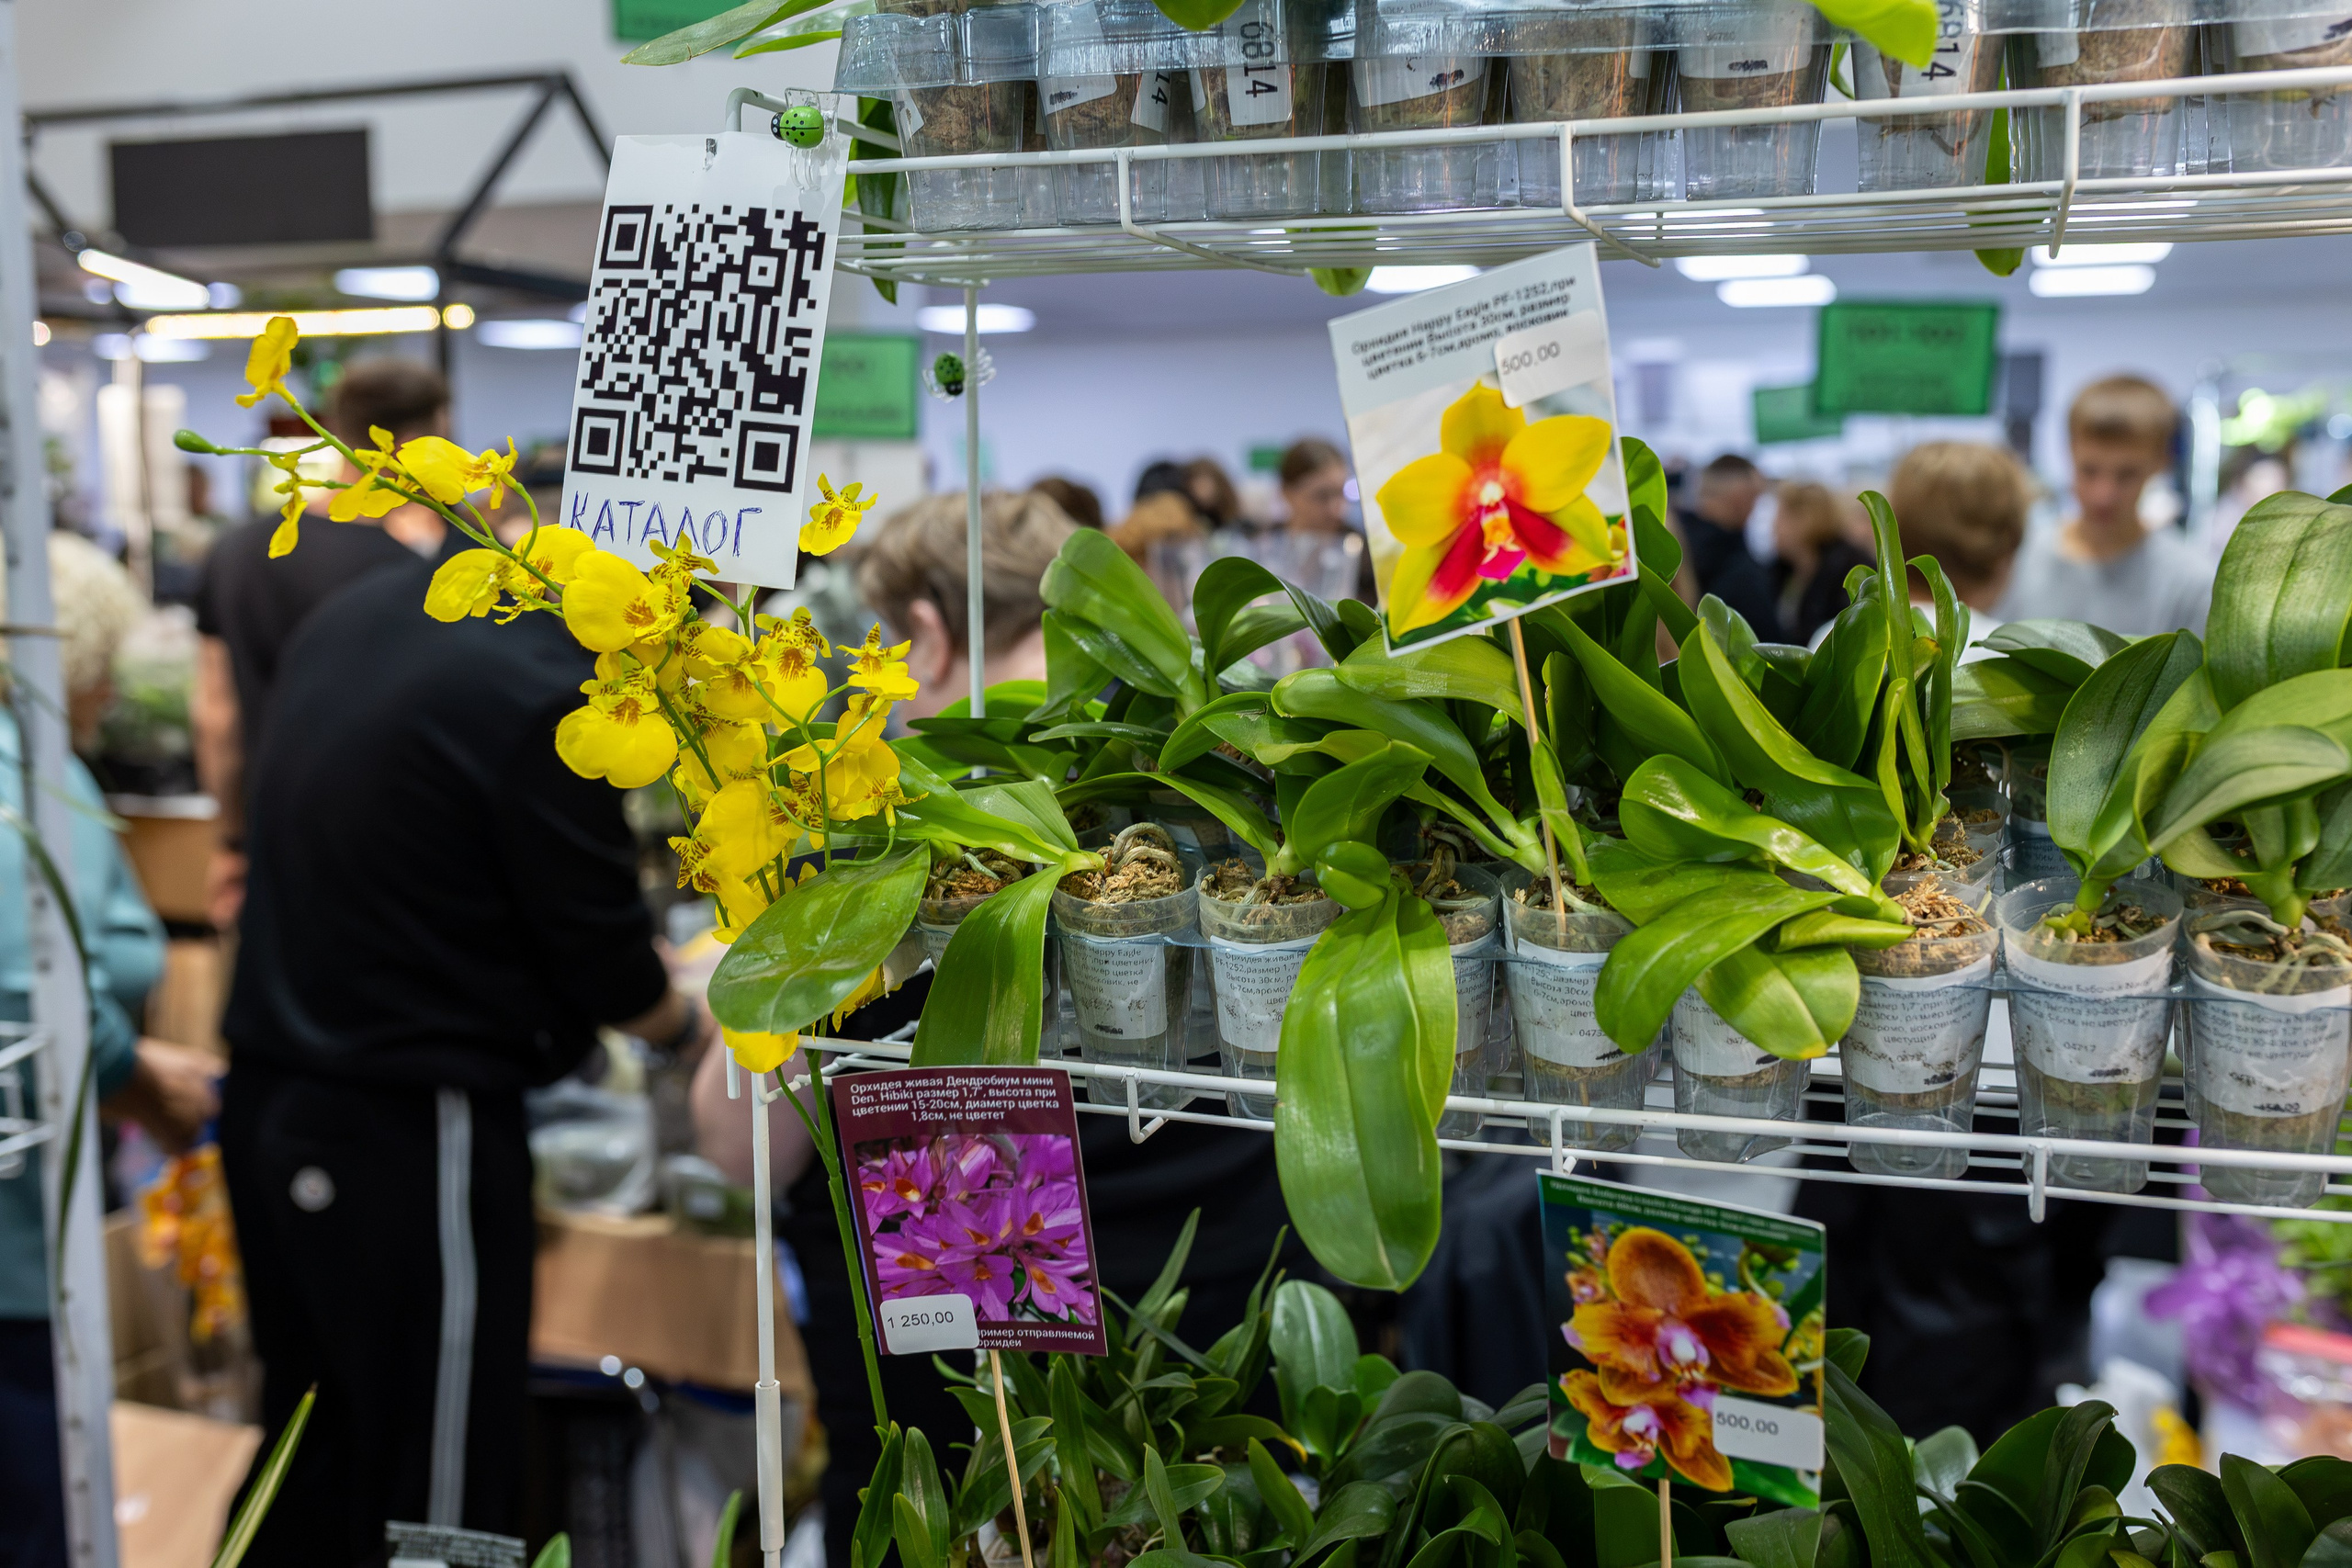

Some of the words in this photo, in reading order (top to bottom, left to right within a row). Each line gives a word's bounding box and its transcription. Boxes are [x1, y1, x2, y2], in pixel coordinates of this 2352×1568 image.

[1240, 21, 1278, 98] 6814
[1455, 299, 1490, 321] Eagle
[571, 491, 763, 558] КАТАЛОГ
[1225, 952, 1262, 964] Орхидея
[1265, 954, 1295, 964] живая
[1283, 961, 1300, 972] 1,7"
[1883, 1032, 1937, 1045] цветущий
[851, 1079, 902, 1094] Орхидея
[905, 1077, 944, 1089] живая
[946, 1075, 1020, 1089] Дендробиум
[1023, 1077, 1054, 1086] мини
[851, 1094, 877, 1105] Den.
[880, 1089, 914, 1101] Hibiki
[916, 1089, 959, 1101] размер
[989, 1088, 1032, 1098] высота
[1035, 1088, 1057, 1099] при
[852, 1103, 910, 1117] цветении
[910, 1100, 963, 1111] 15-20см,
[966, 1100, 1015, 1111] диаметр
[1017, 1100, 1060, 1110] цветка
[910, 1111, 947, 1122] 1,8см,
[949, 1111, 964, 1121] не
[966, 1111, 1006, 1122] цветет
[1017, 1329, 1095, 1340] отправляемой
